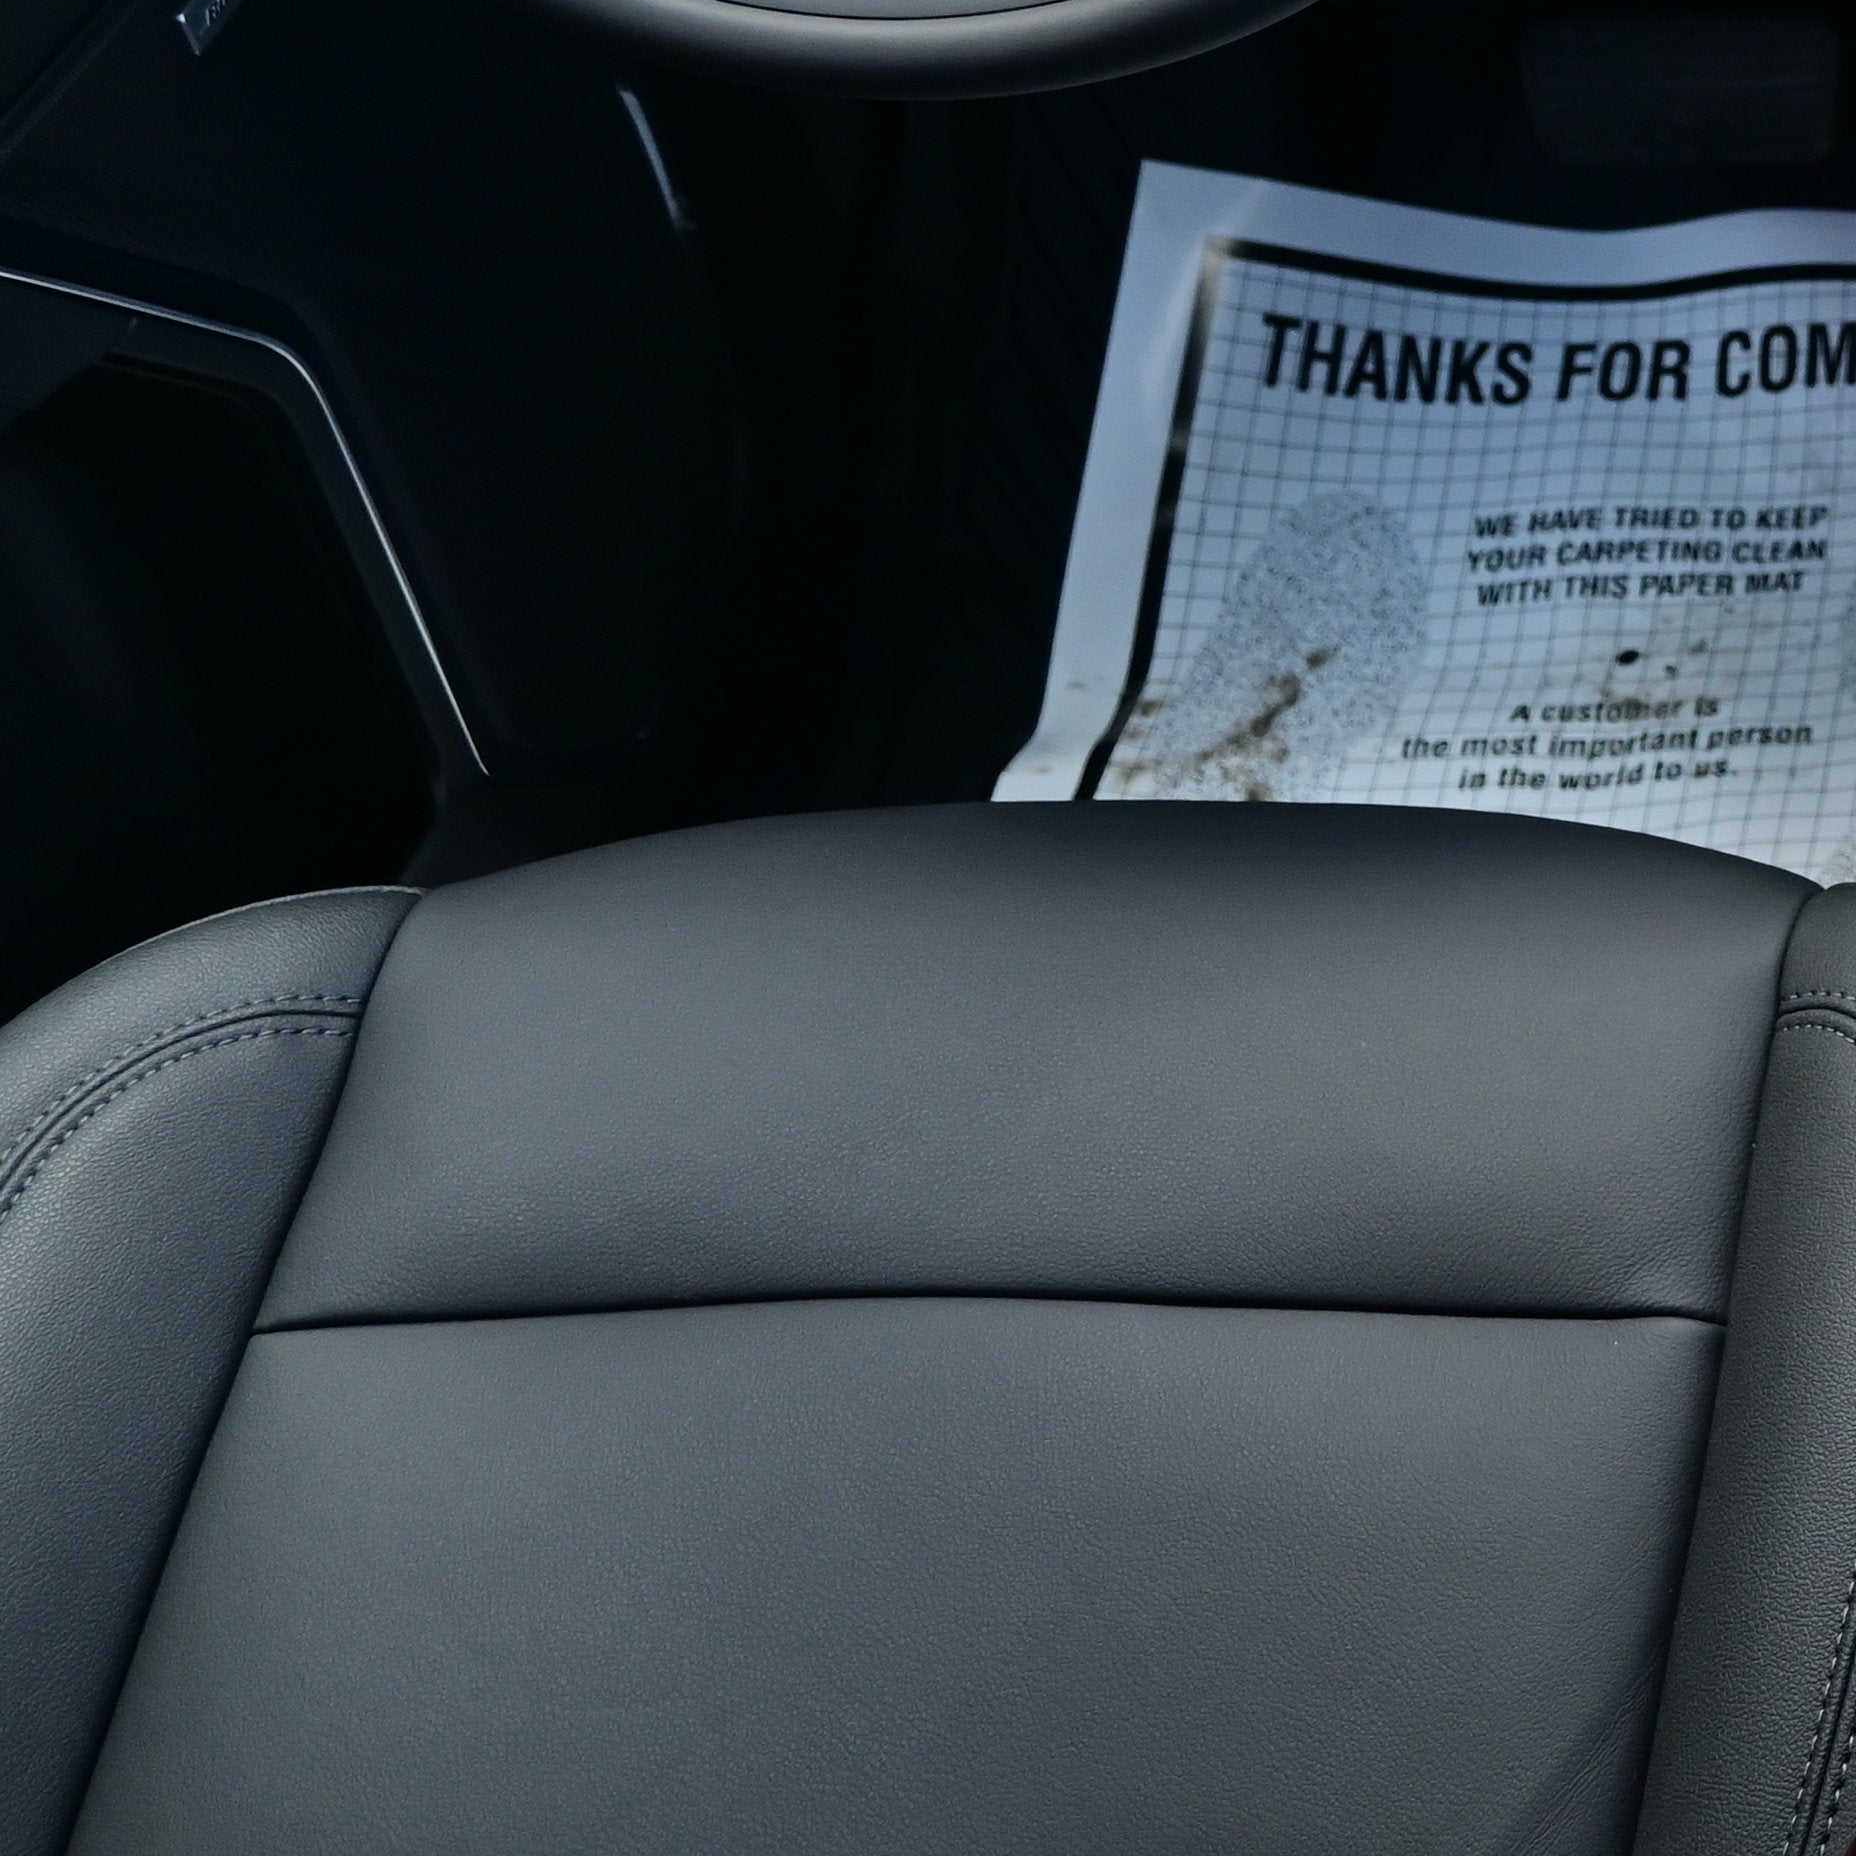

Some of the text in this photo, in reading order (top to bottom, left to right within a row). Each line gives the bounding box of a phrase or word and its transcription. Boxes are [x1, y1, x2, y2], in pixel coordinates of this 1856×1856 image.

[1263, 312, 1533, 406] THANKS
[1557, 339, 1691, 403] FOR
[1474, 505, 1829, 539] WE HAVE TRIED TO KEEP
[1467, 538, 1829, 574] YOUR CARPETING CLEAN
[1476, 570, 1806, 607] WITH THIS PAPER MAT
[1508, 703, 1532, 724] A
[1694, 694, 1720, 718] is
[1401, 721, 1814, 762] the most important person
[1457, 767, 1487, 791] in
[1498, 766, 1546, 790] the
[1558, 760, 1645, 791] world
[1654, 759, 1683, 781] to
